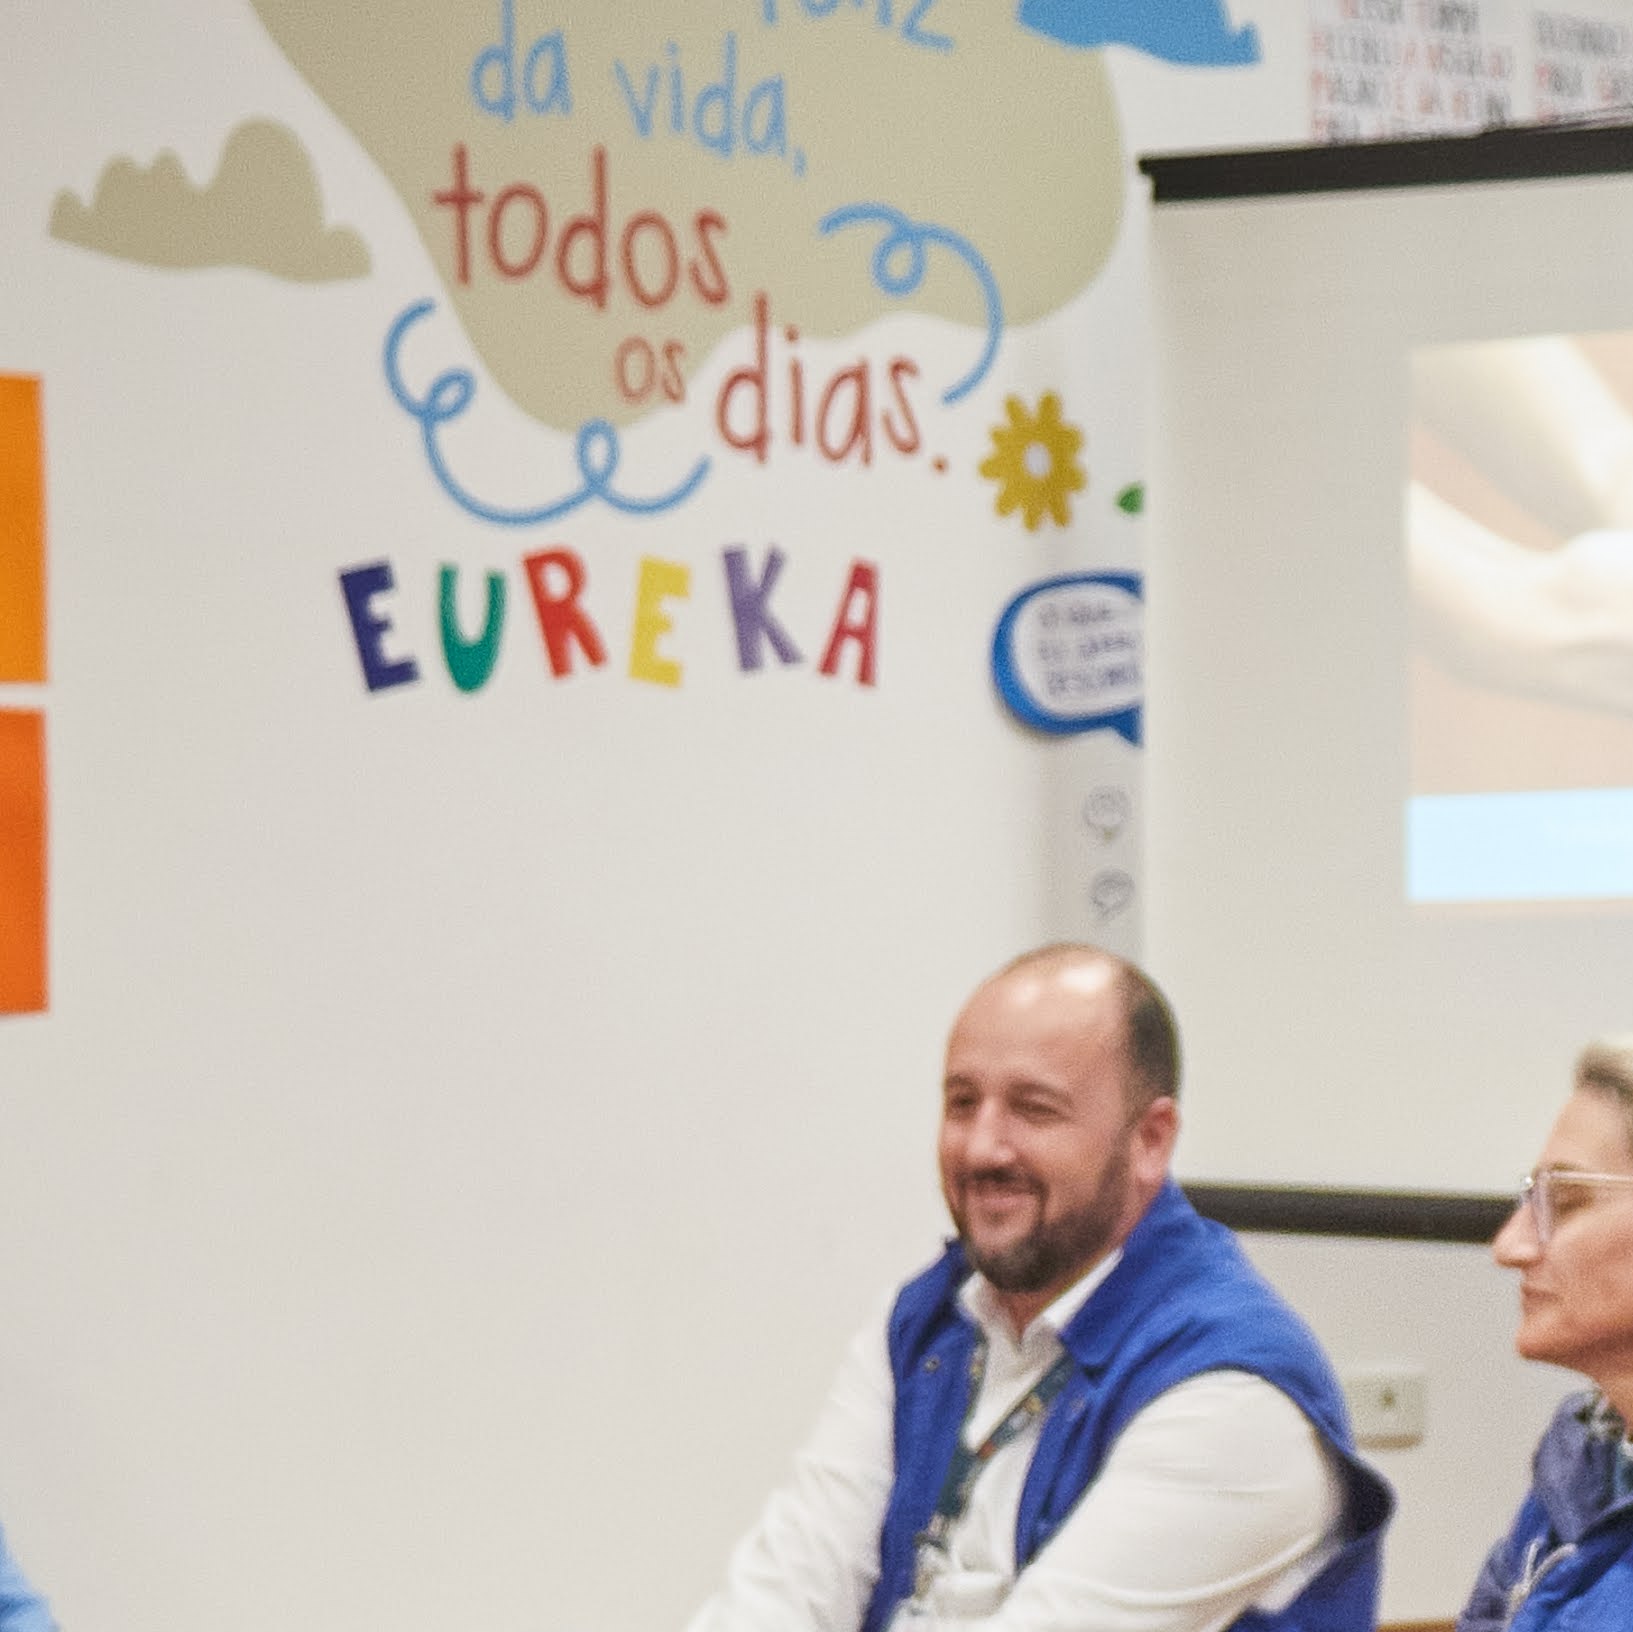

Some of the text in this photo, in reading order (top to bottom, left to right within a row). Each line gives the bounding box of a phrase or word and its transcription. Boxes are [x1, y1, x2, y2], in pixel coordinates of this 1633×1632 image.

[469, 0, 807, 177] da vida,
[431, 145, 729, 311] todos
[615, 292, 950, 475] os dias.
[337, 545, 882, 695] EUREKA
